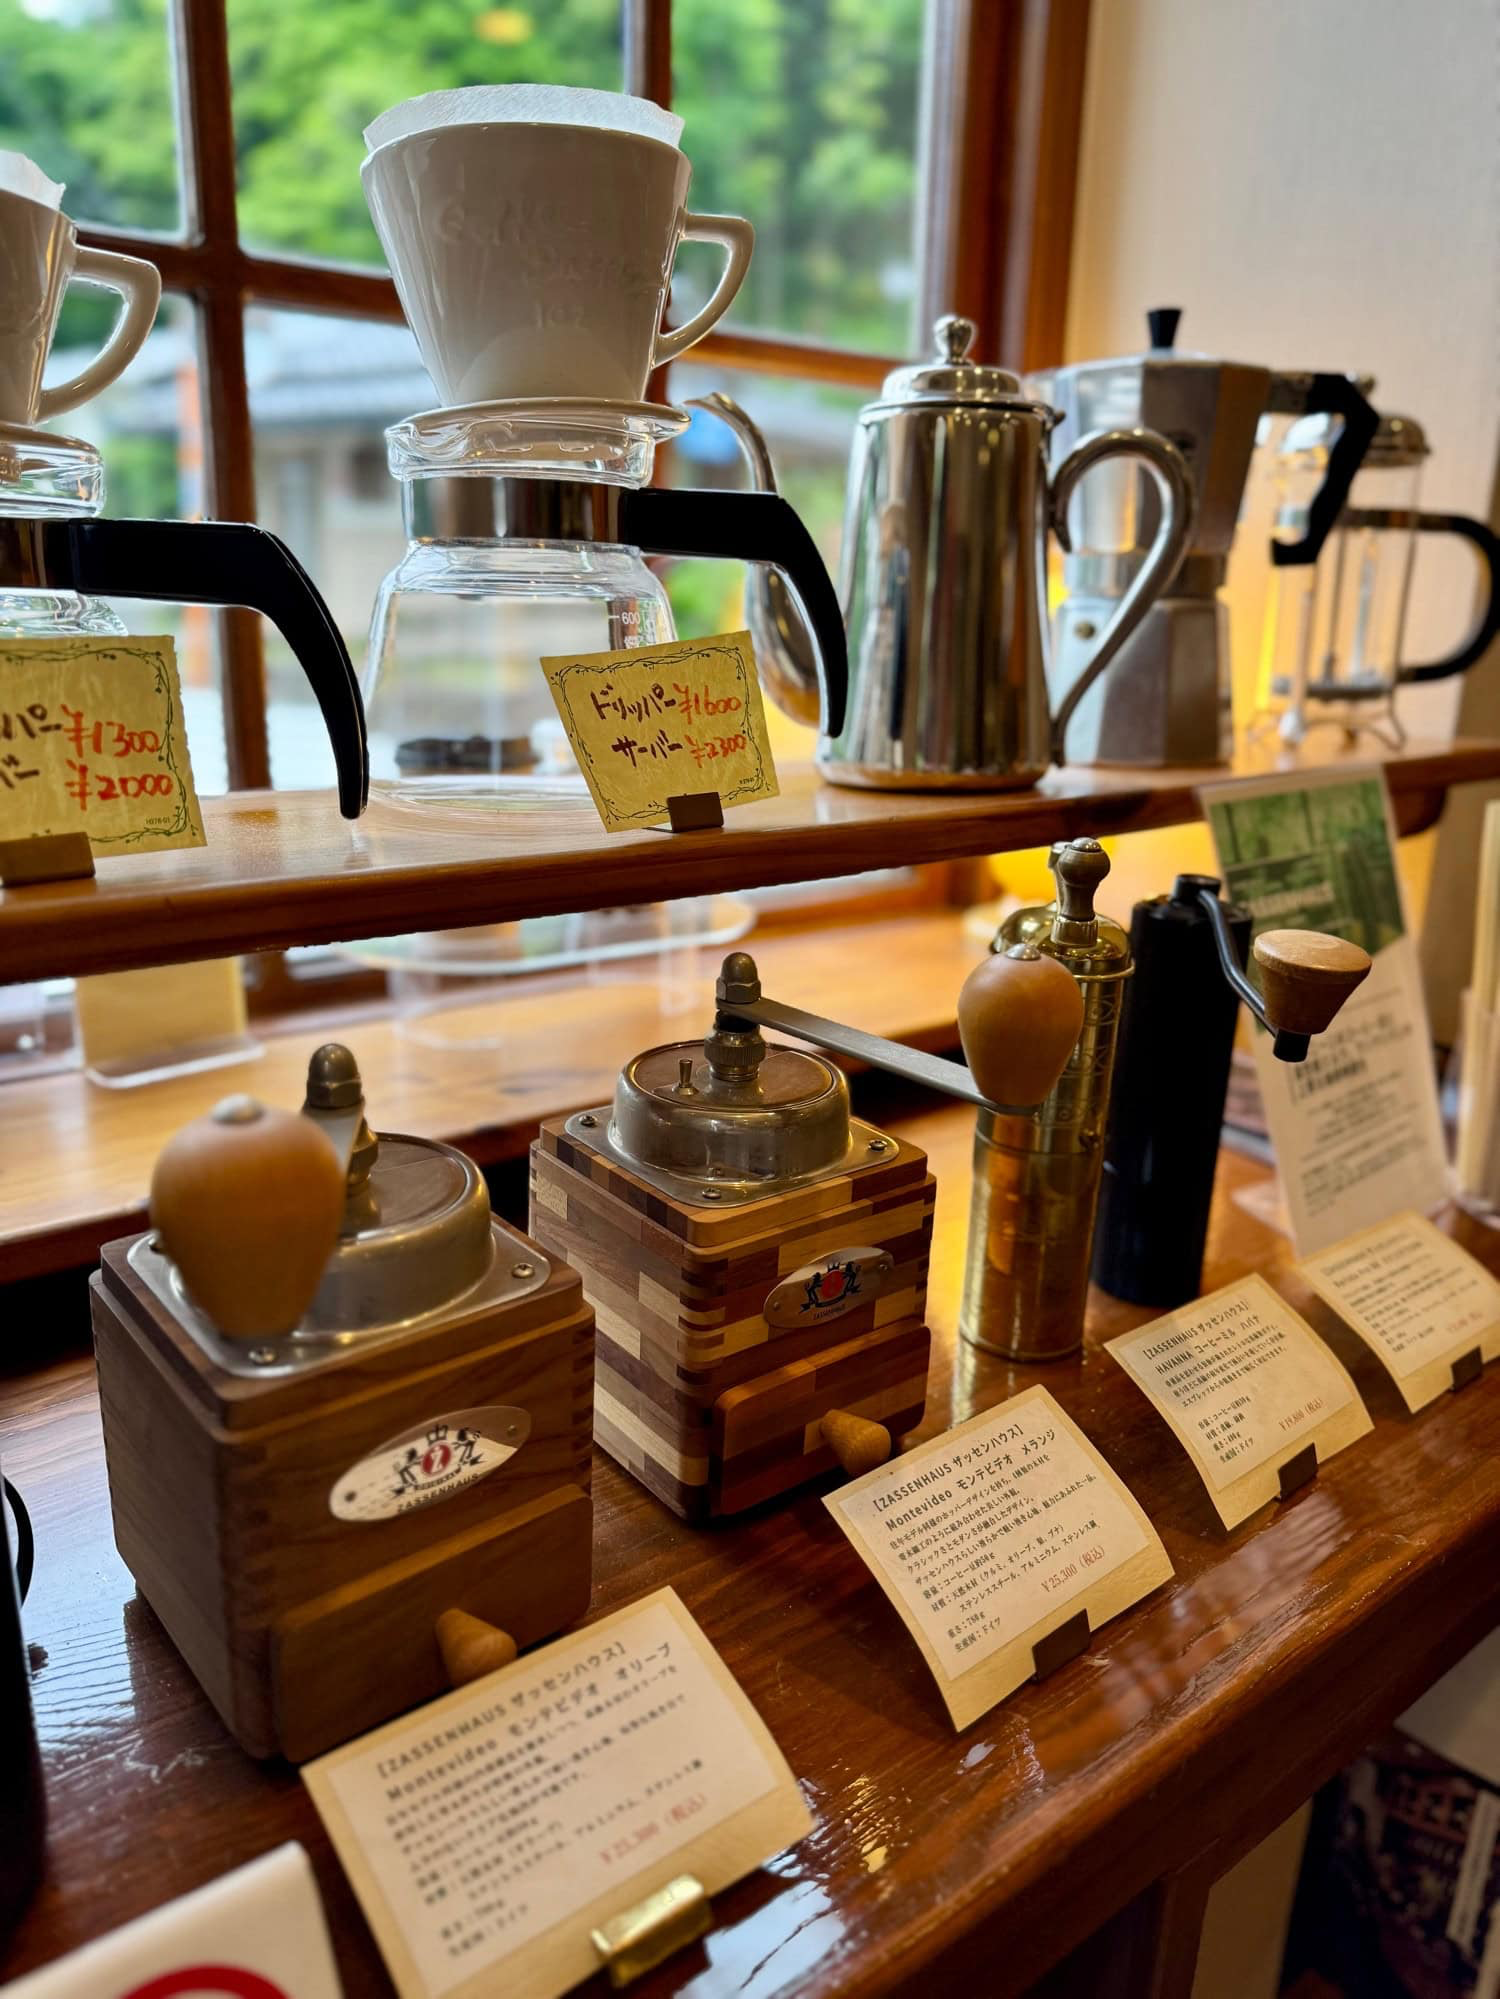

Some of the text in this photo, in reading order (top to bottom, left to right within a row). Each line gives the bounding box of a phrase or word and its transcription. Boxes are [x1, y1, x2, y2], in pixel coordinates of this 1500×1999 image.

[621, 612, 640, 624] 600
[589, 681, 677, 723] ドリッパー
[611, 728, 683, 768] サーバー
[1154, 1349, 1194, 1375] HAVANNA
[1193, 1327, 1237, 1354] コーヒーミル
[950, 1423, 1025, 1470] ザッセンハウス】
[883, 1427, 1059, 1532] Montevideo モンテビデオ メランジ
[384, 1734, 499, 1803] Montevideo
[611, 1640, 675, 1682] オリーブ
